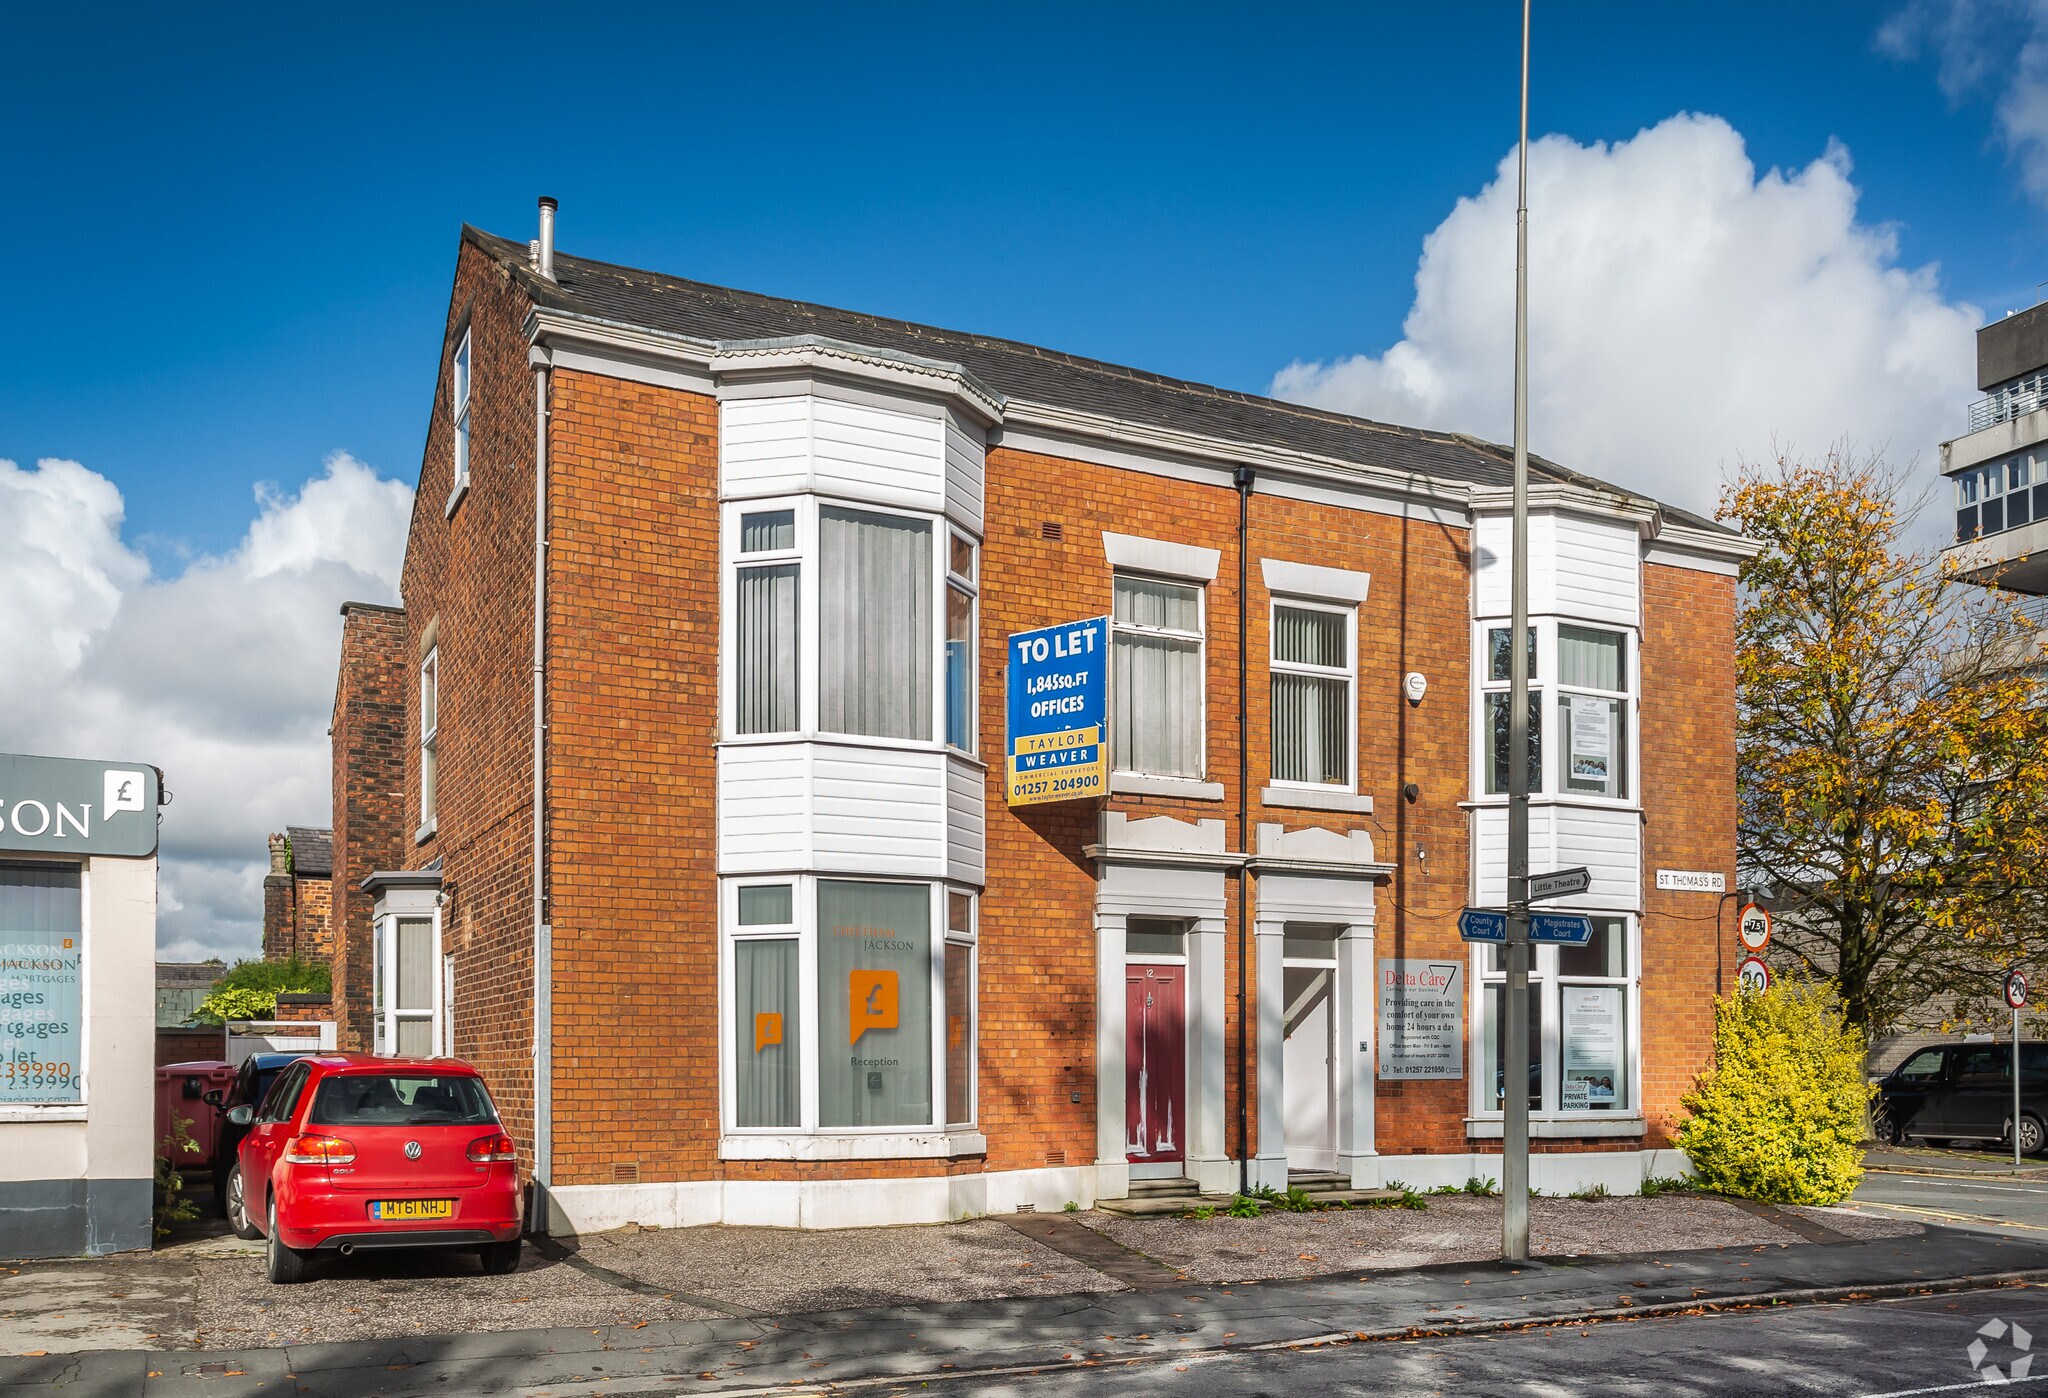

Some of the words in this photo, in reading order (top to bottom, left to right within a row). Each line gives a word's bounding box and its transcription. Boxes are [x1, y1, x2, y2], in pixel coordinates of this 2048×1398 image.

[1018, 637, 1049, 665] TO
[1055, 627, 1098, 659] LET
[1031, 695, 1085, 718] OFFICES
[1029, 733, 1085, 750] TAYLOR
[1025, 749, 1088, 768] WEAVER
[1015, 771, 1057, 781] COMMERCIAL
[1061, 766, 1099, 776] SURVEYORS
[1014, 781, 1048, 796] 01257
[1052, 775, 1099, 792] 204900
[0, 799, 93, 839] ON
[1534, 882, 1552, 892] Little
[1554, 878, 1581, 889] Theatre
[1470, 915, 1494, 927] County
[1543, 918, 1581, 929] Magistrates
[832, 926, 896, 938] CHEETHAM
[1472, 926, 1490, 936] Court
[1553, 928, 1572, 938] Court
[864, 940, 914, 951] JACKSON
[1146, 968, 1154, 978] 12
[1386, 970, 1416, 986] Delta
[1420, 970, 1446, 986] Care
[2011, 982, 2024, 998] 20
[1386, 998, 1418, 1009] Providing
[1436, 999, 1443, 1007] in
[1444, 999, 1456, 1008] the
[1386, 1010, 1414, 1019] comfort
[1416, 1010, 1423, 1018] of
[1424, 1012, 1440, 1021] your
[1386, 1022, 1405, 1031] home
[1406, 1022, 1414, 1030] 24
[1416, 1022, 1436, 1031] hours
[1442, 1023, 1454, 1034] day
[850, 1056, 899, 1069] Reception
[421, 1200, 446, 1214] NHJ
